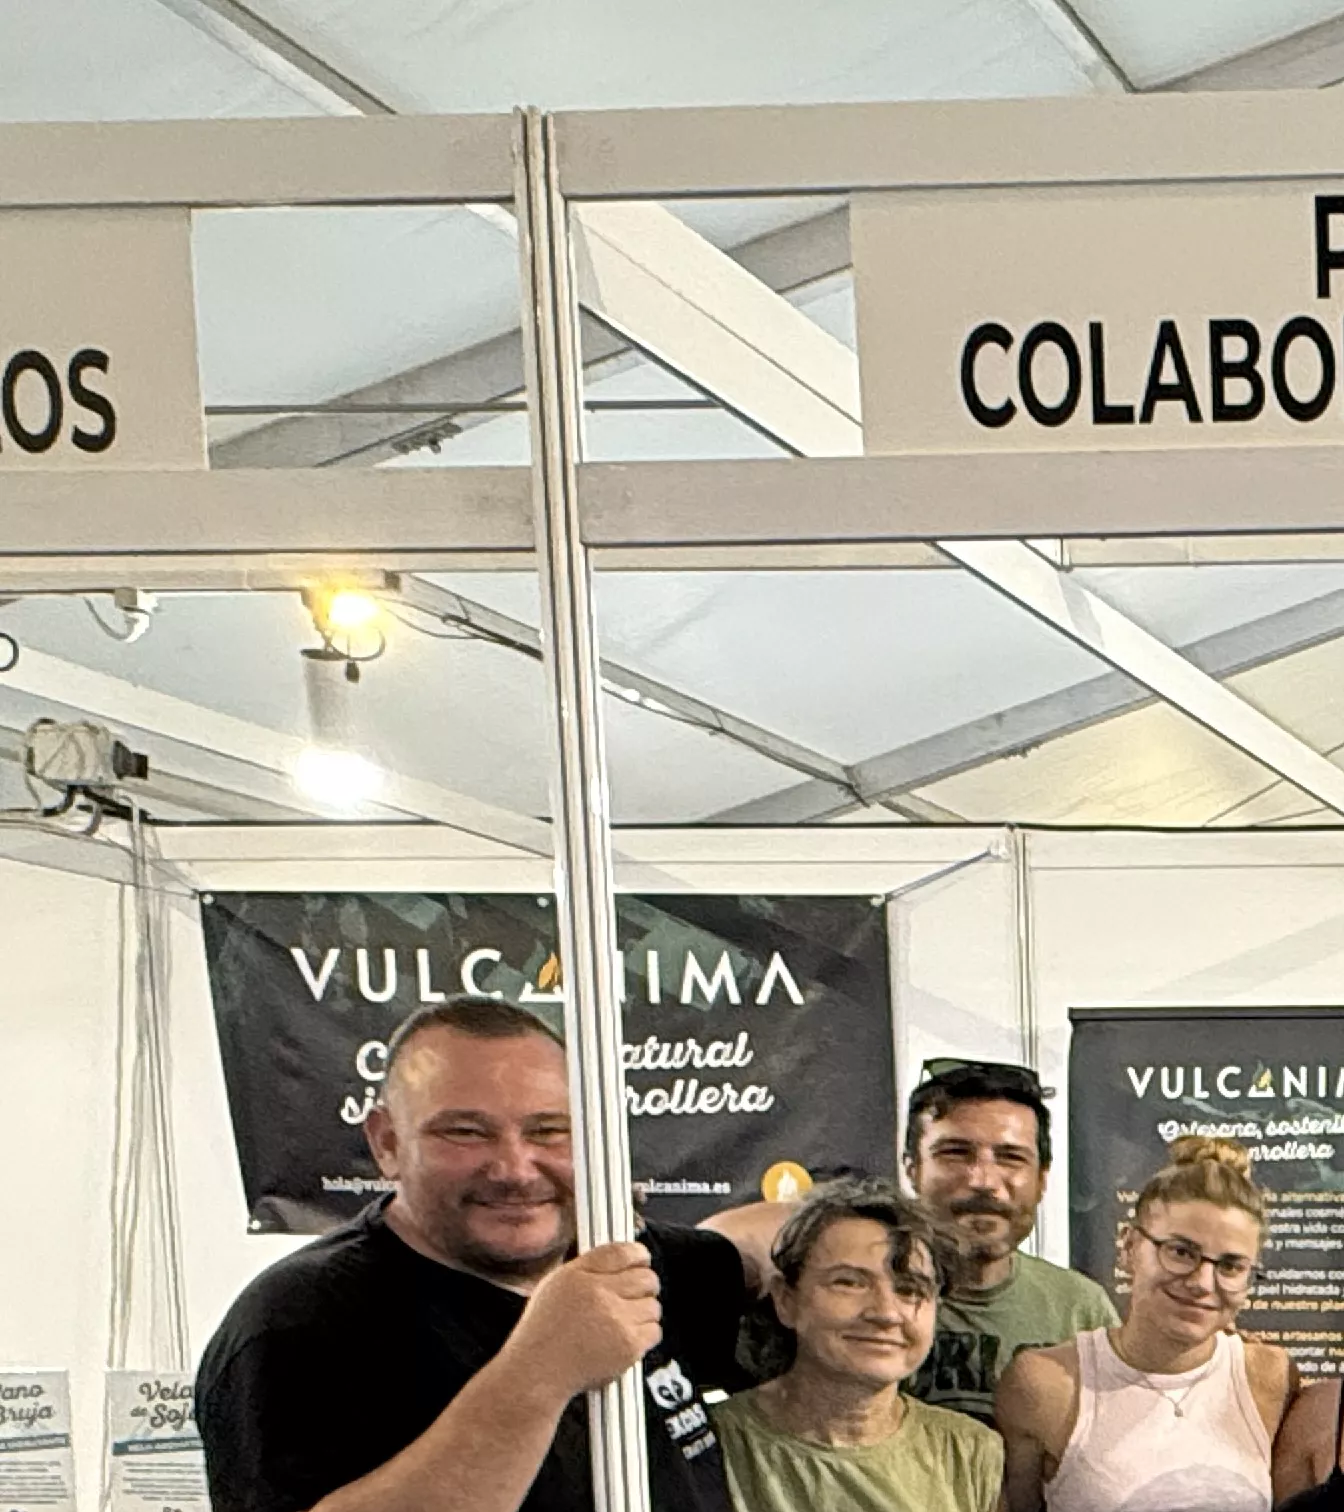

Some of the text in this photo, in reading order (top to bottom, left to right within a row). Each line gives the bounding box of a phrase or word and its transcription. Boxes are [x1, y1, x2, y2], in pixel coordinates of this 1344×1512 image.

[0, 348, 118, 453] OS
[290, 947, 805, 1005] VULCAIMA
[622, 1031, 754, 1070] atural
[625, 1078, 775, 1115] rollera
[1246, 1142, 1335, 1162] nrollera
